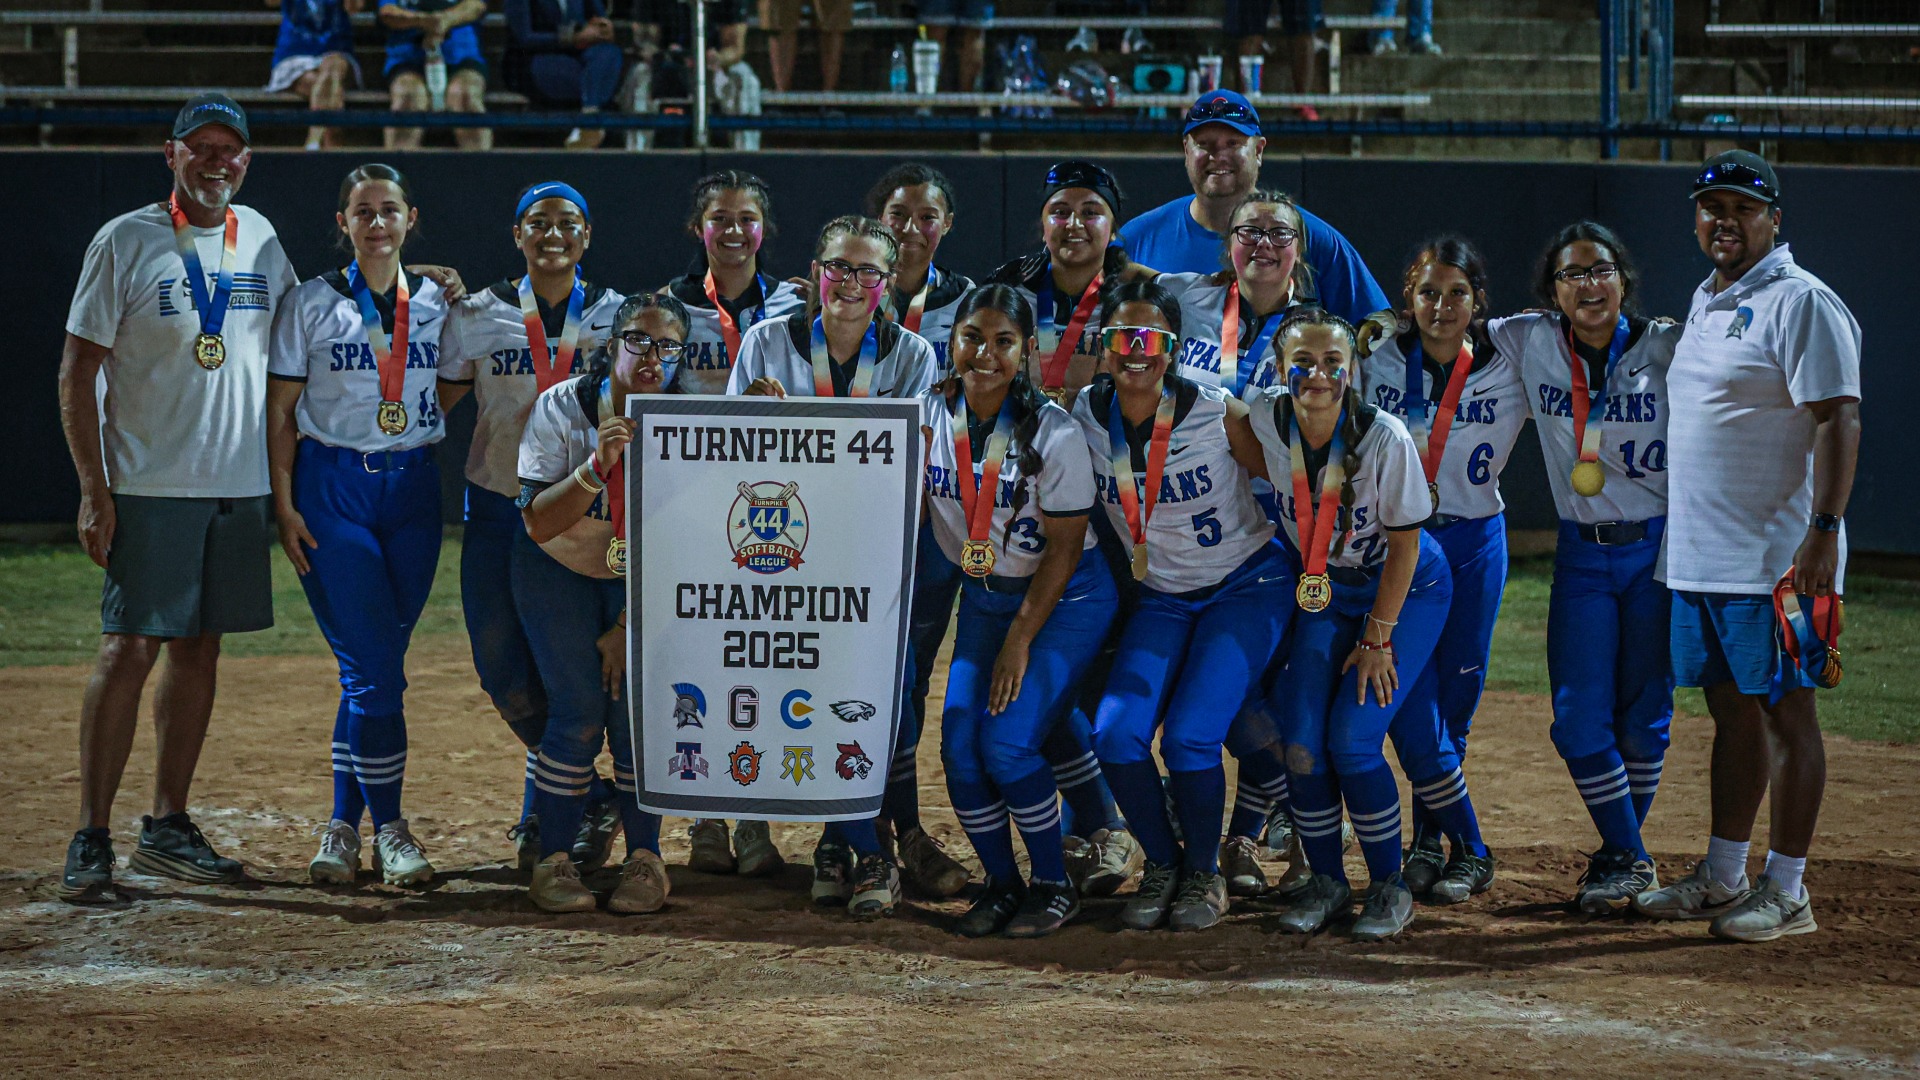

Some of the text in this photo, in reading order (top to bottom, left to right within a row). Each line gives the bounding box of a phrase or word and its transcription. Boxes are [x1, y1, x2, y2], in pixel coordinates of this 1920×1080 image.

[1373, 384, 1498, 425] SPAANS
[1539, 383, 1657, 423] SPAANS
[653, 426, 894, 464] TURNPIKE 44
[1467, 443, 1494, 485] 6
[1619, 440, 1668, 478] 10
[1095, 464, 1213, 505] PAANS
[752, 508, 783, 533] 44
[1011, 517, 1047, 553] 3
[1191, 507, 1223, 547] 5
[740, 544, 794, 559] SOFTBALL
[749, 557, 786, 566] LEAGUE
[971, 552, 985, 562] 44
[676, 583, 871, 622] CHAMPION
[1307, 586, 1320, 597] 44
[723, 630, 820, 669] 2025
[727, 685, 760, 731] G
[668, 754, 709, 779] HALE
